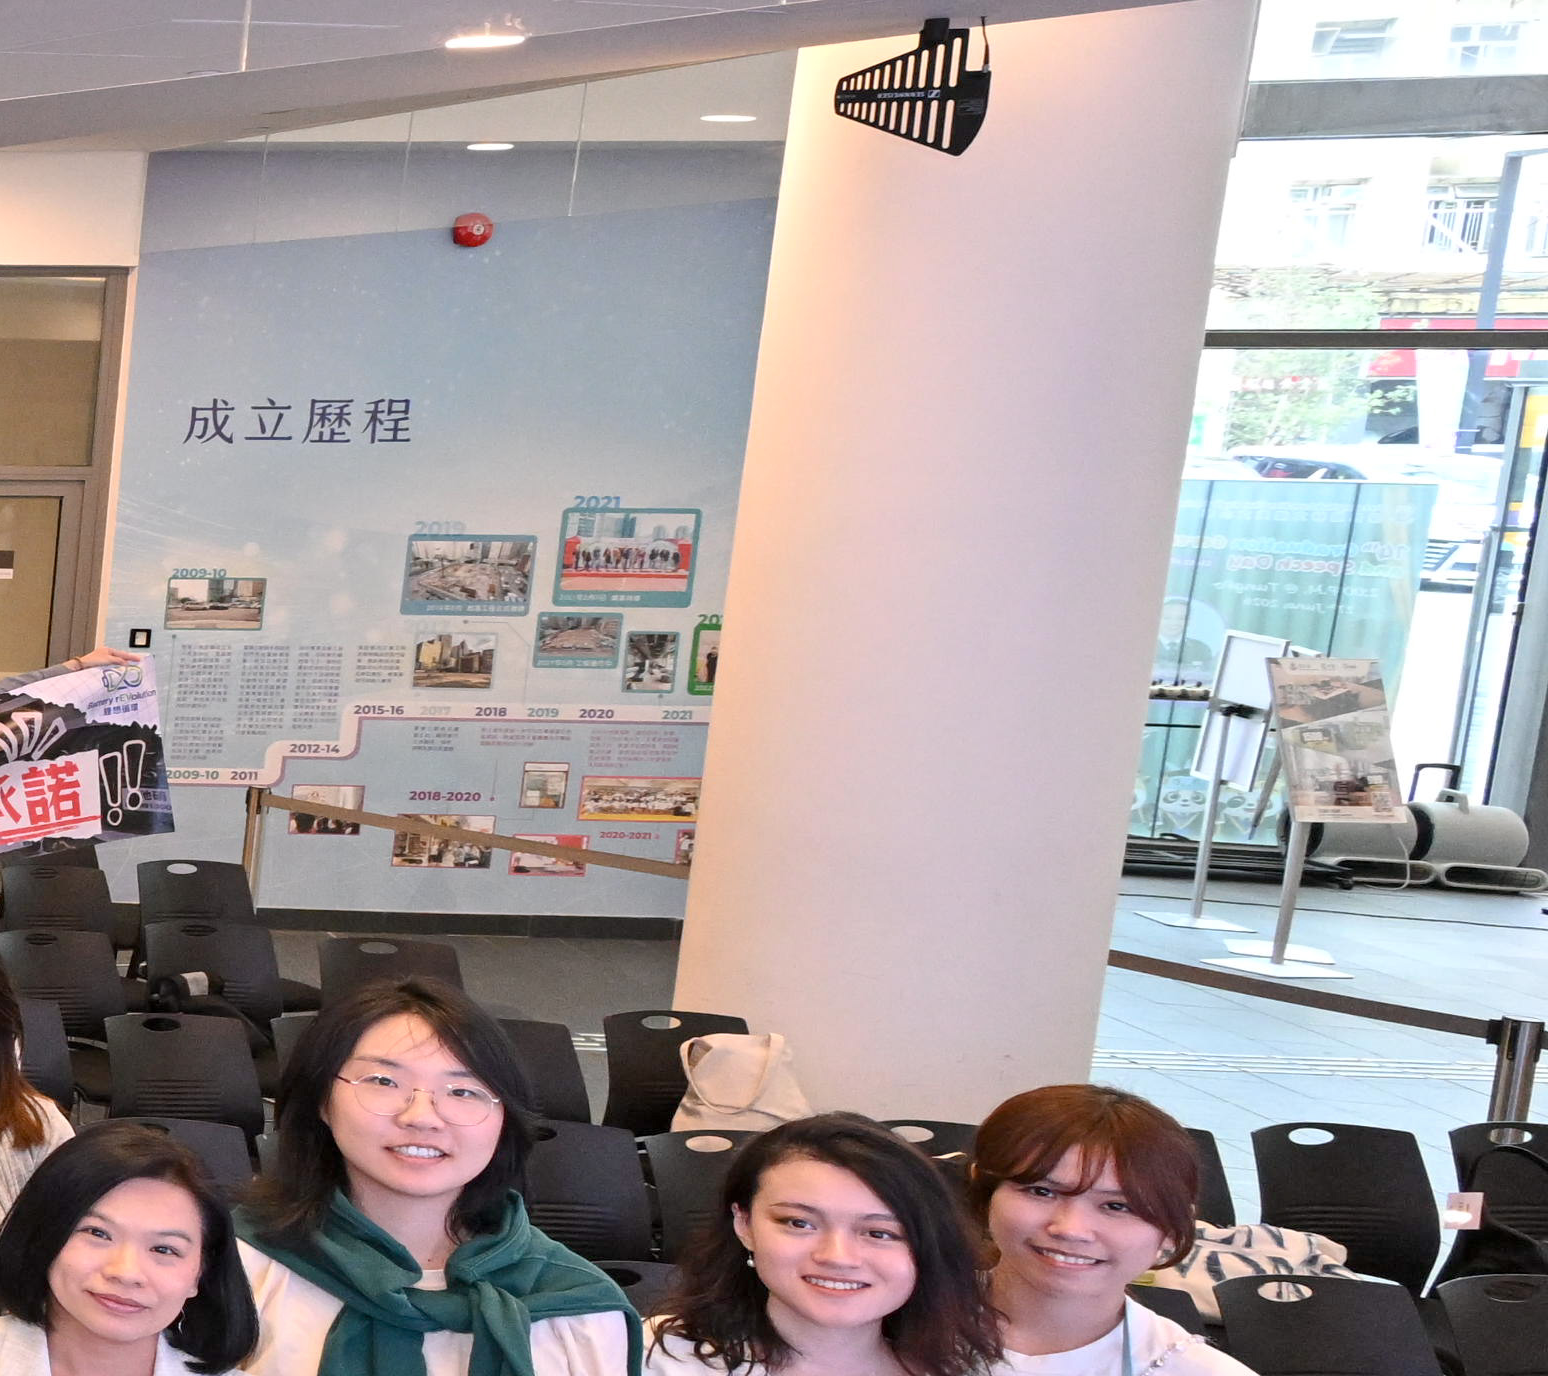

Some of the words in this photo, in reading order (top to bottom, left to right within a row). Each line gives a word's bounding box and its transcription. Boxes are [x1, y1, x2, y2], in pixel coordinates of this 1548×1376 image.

[183, 397, 412, 445] 成立歷程
[574, 495, 621, 509] 2021
[354, 705, 404, 715] 2015-16
[476, 706, 507, 717] 2018
[527, 707, 559, 718] 2019
[580, 708, 614, 719] 2020
[662, 710, 692, 721] 2021
[289, 743, 340, 754] 2012-14
[167, 770, 219, 780] 2009-10
[230, 771, 258, 781] 2011
[409, 791, 481, 802] 2018-2020
[600, 831, 652, 840] 2020-2021
